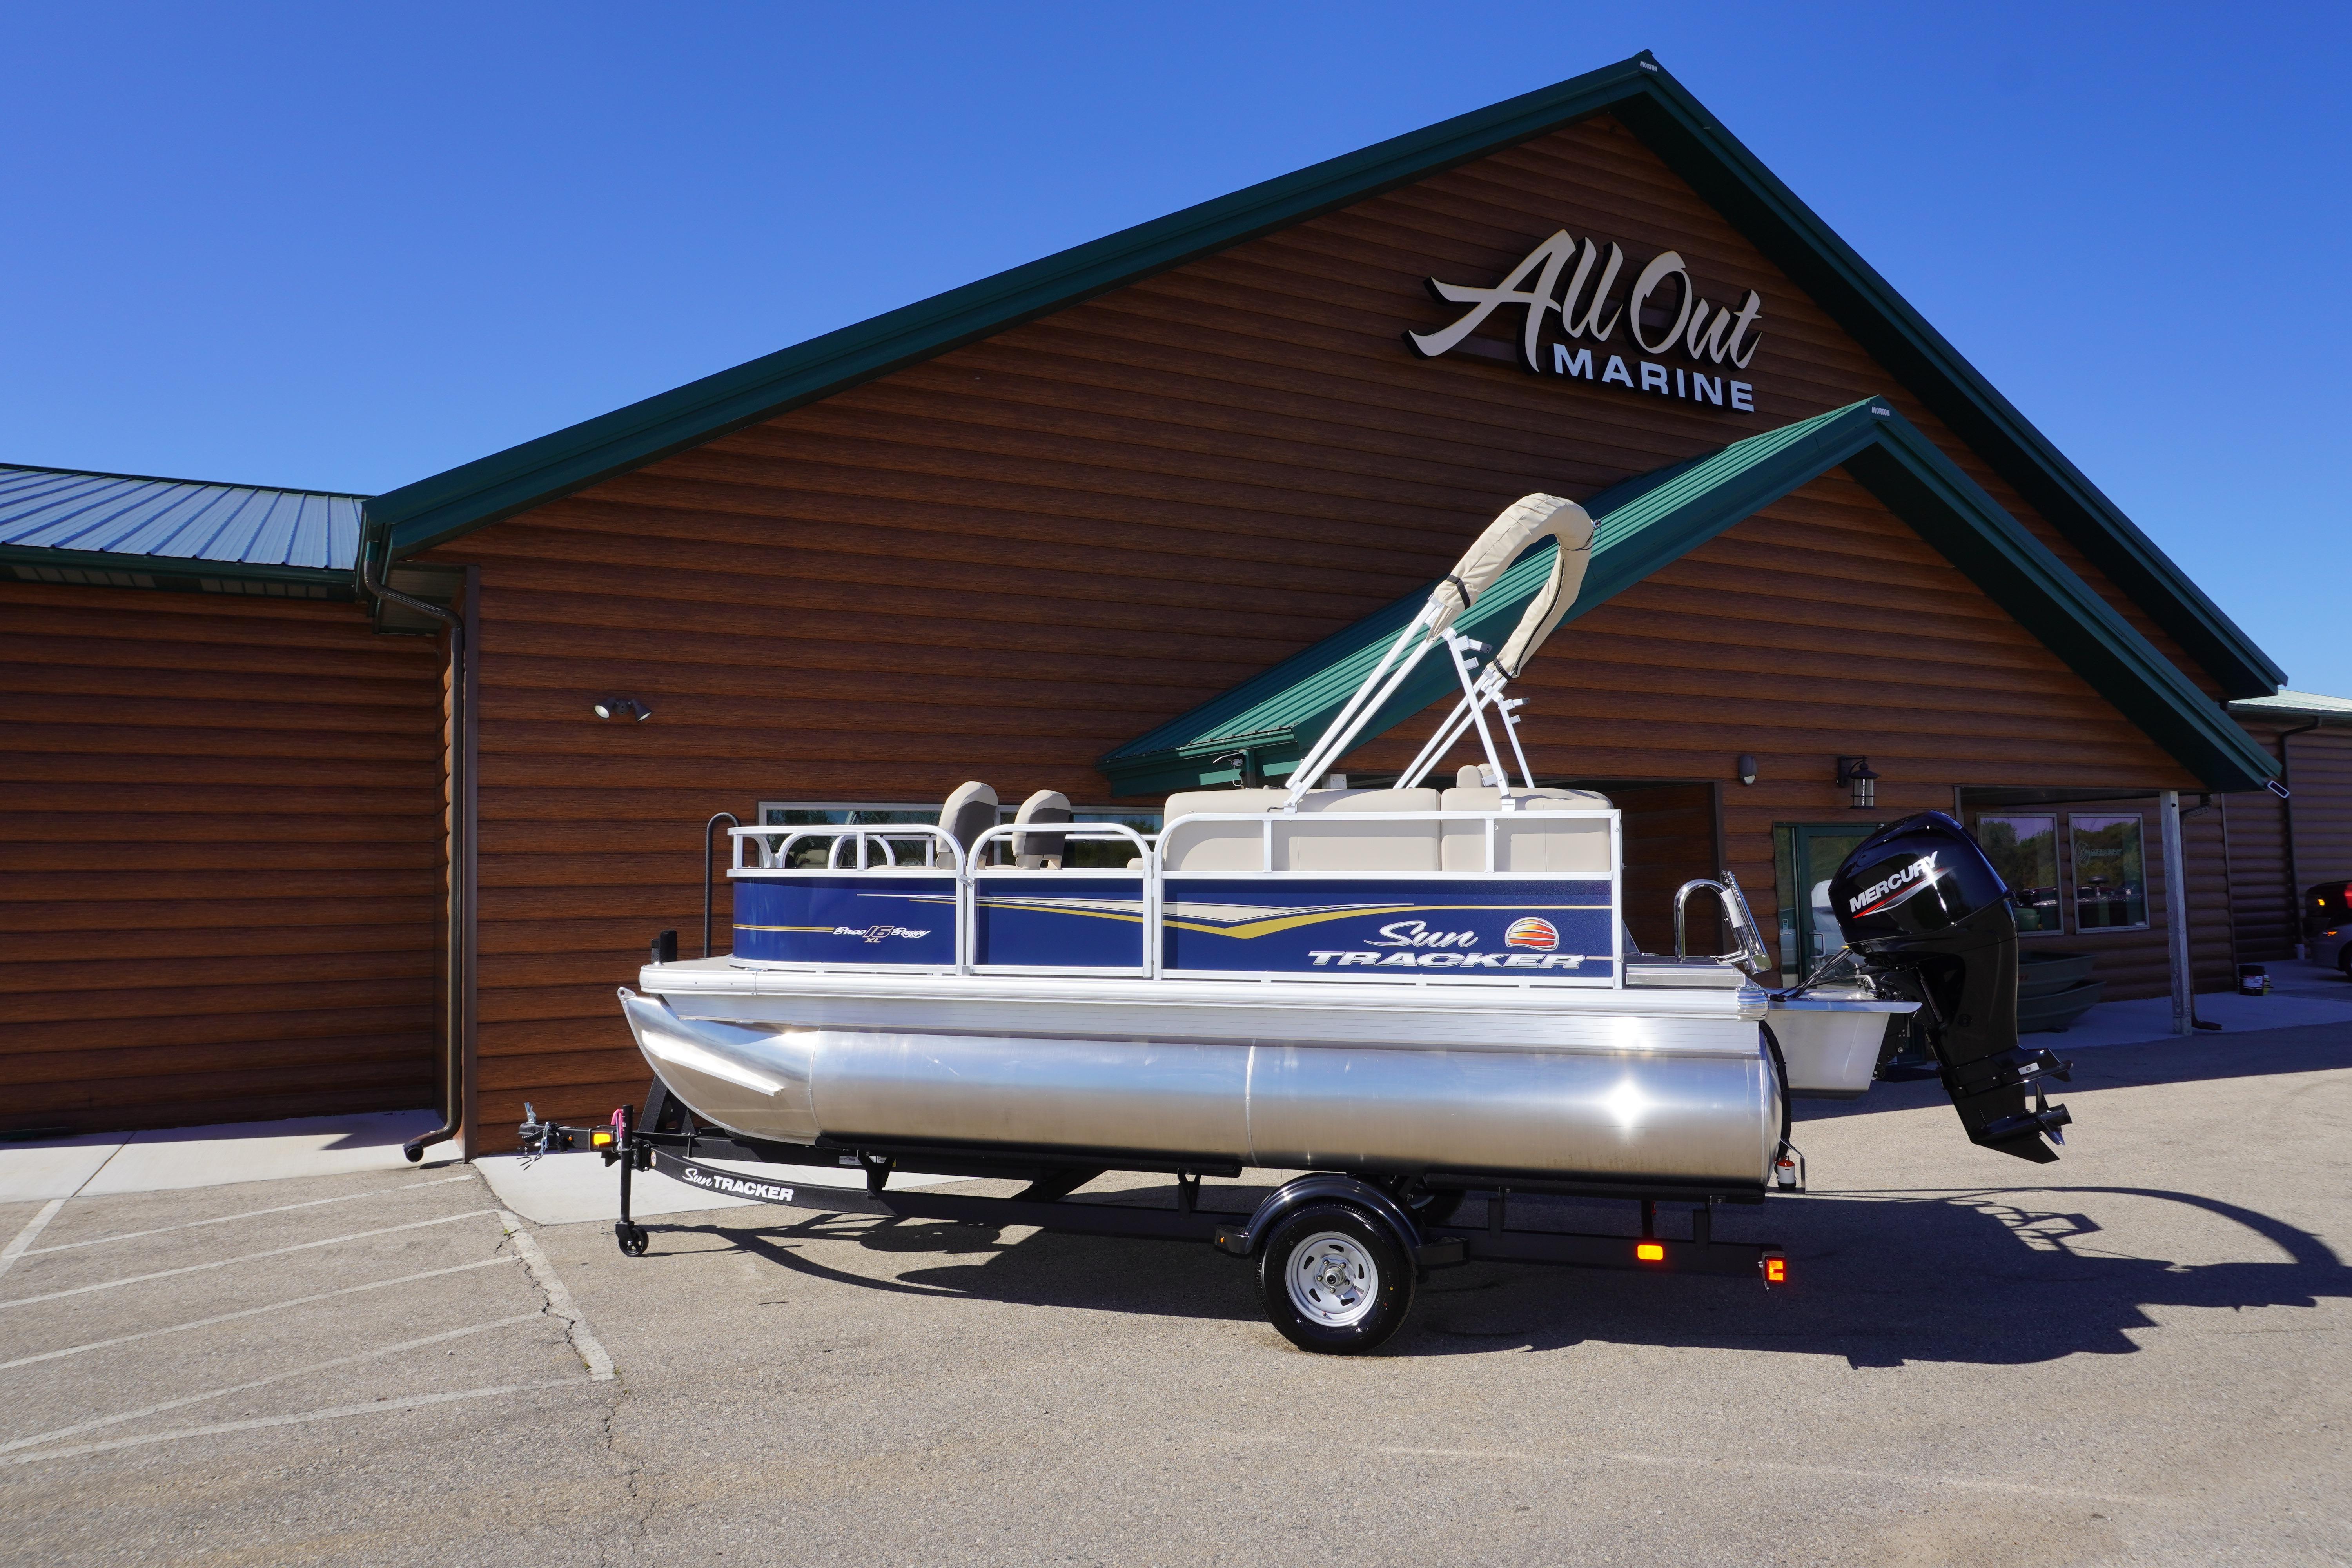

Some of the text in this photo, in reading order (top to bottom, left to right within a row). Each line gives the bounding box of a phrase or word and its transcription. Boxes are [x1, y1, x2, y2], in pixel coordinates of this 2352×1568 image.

[1640, 60, 1658, 72] MORTON
[1407, 228, 1763, 373] All Out
[1552, 343, 1755, 412] MARINE
[1871, 406, 1890, 416] MORTON
[1849, 851, 1938, 913] MERCURY
[833, 926, 931, 938] Bass 16 Buggy
[1364, 920, 1479, 948] Sun
[1308, 951, 1586, 969] TRACKER
[682, 1168, 794, 1201] Sun TRACKER
